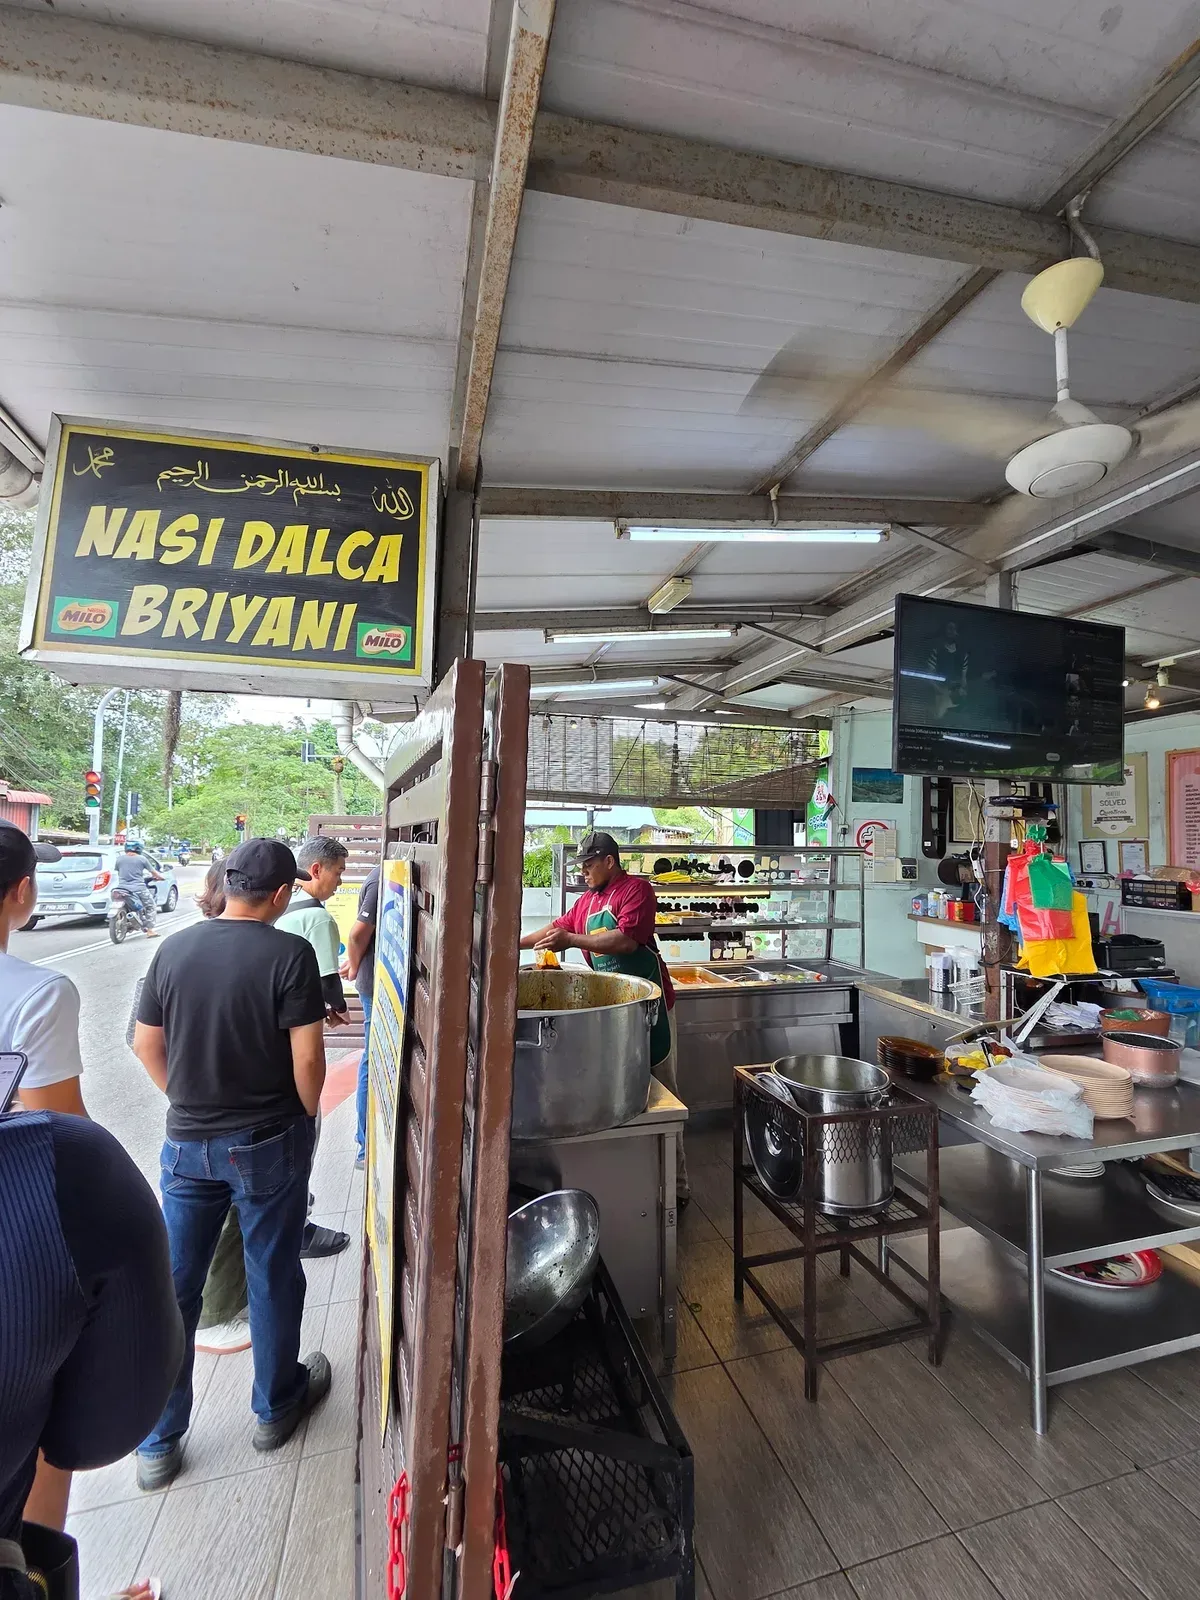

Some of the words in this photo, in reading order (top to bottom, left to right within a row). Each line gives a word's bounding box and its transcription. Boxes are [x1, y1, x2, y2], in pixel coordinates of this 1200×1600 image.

[74, 505, 225, 566] NASI
[232, 520, 404, 584] DALCA
[62, 609, 106, 624] MILO
[120, 584, 358, 651] BRIYANI
[364, 634, 402, 648] MILO
[1099, 799, 1127, 807] SOLVED
